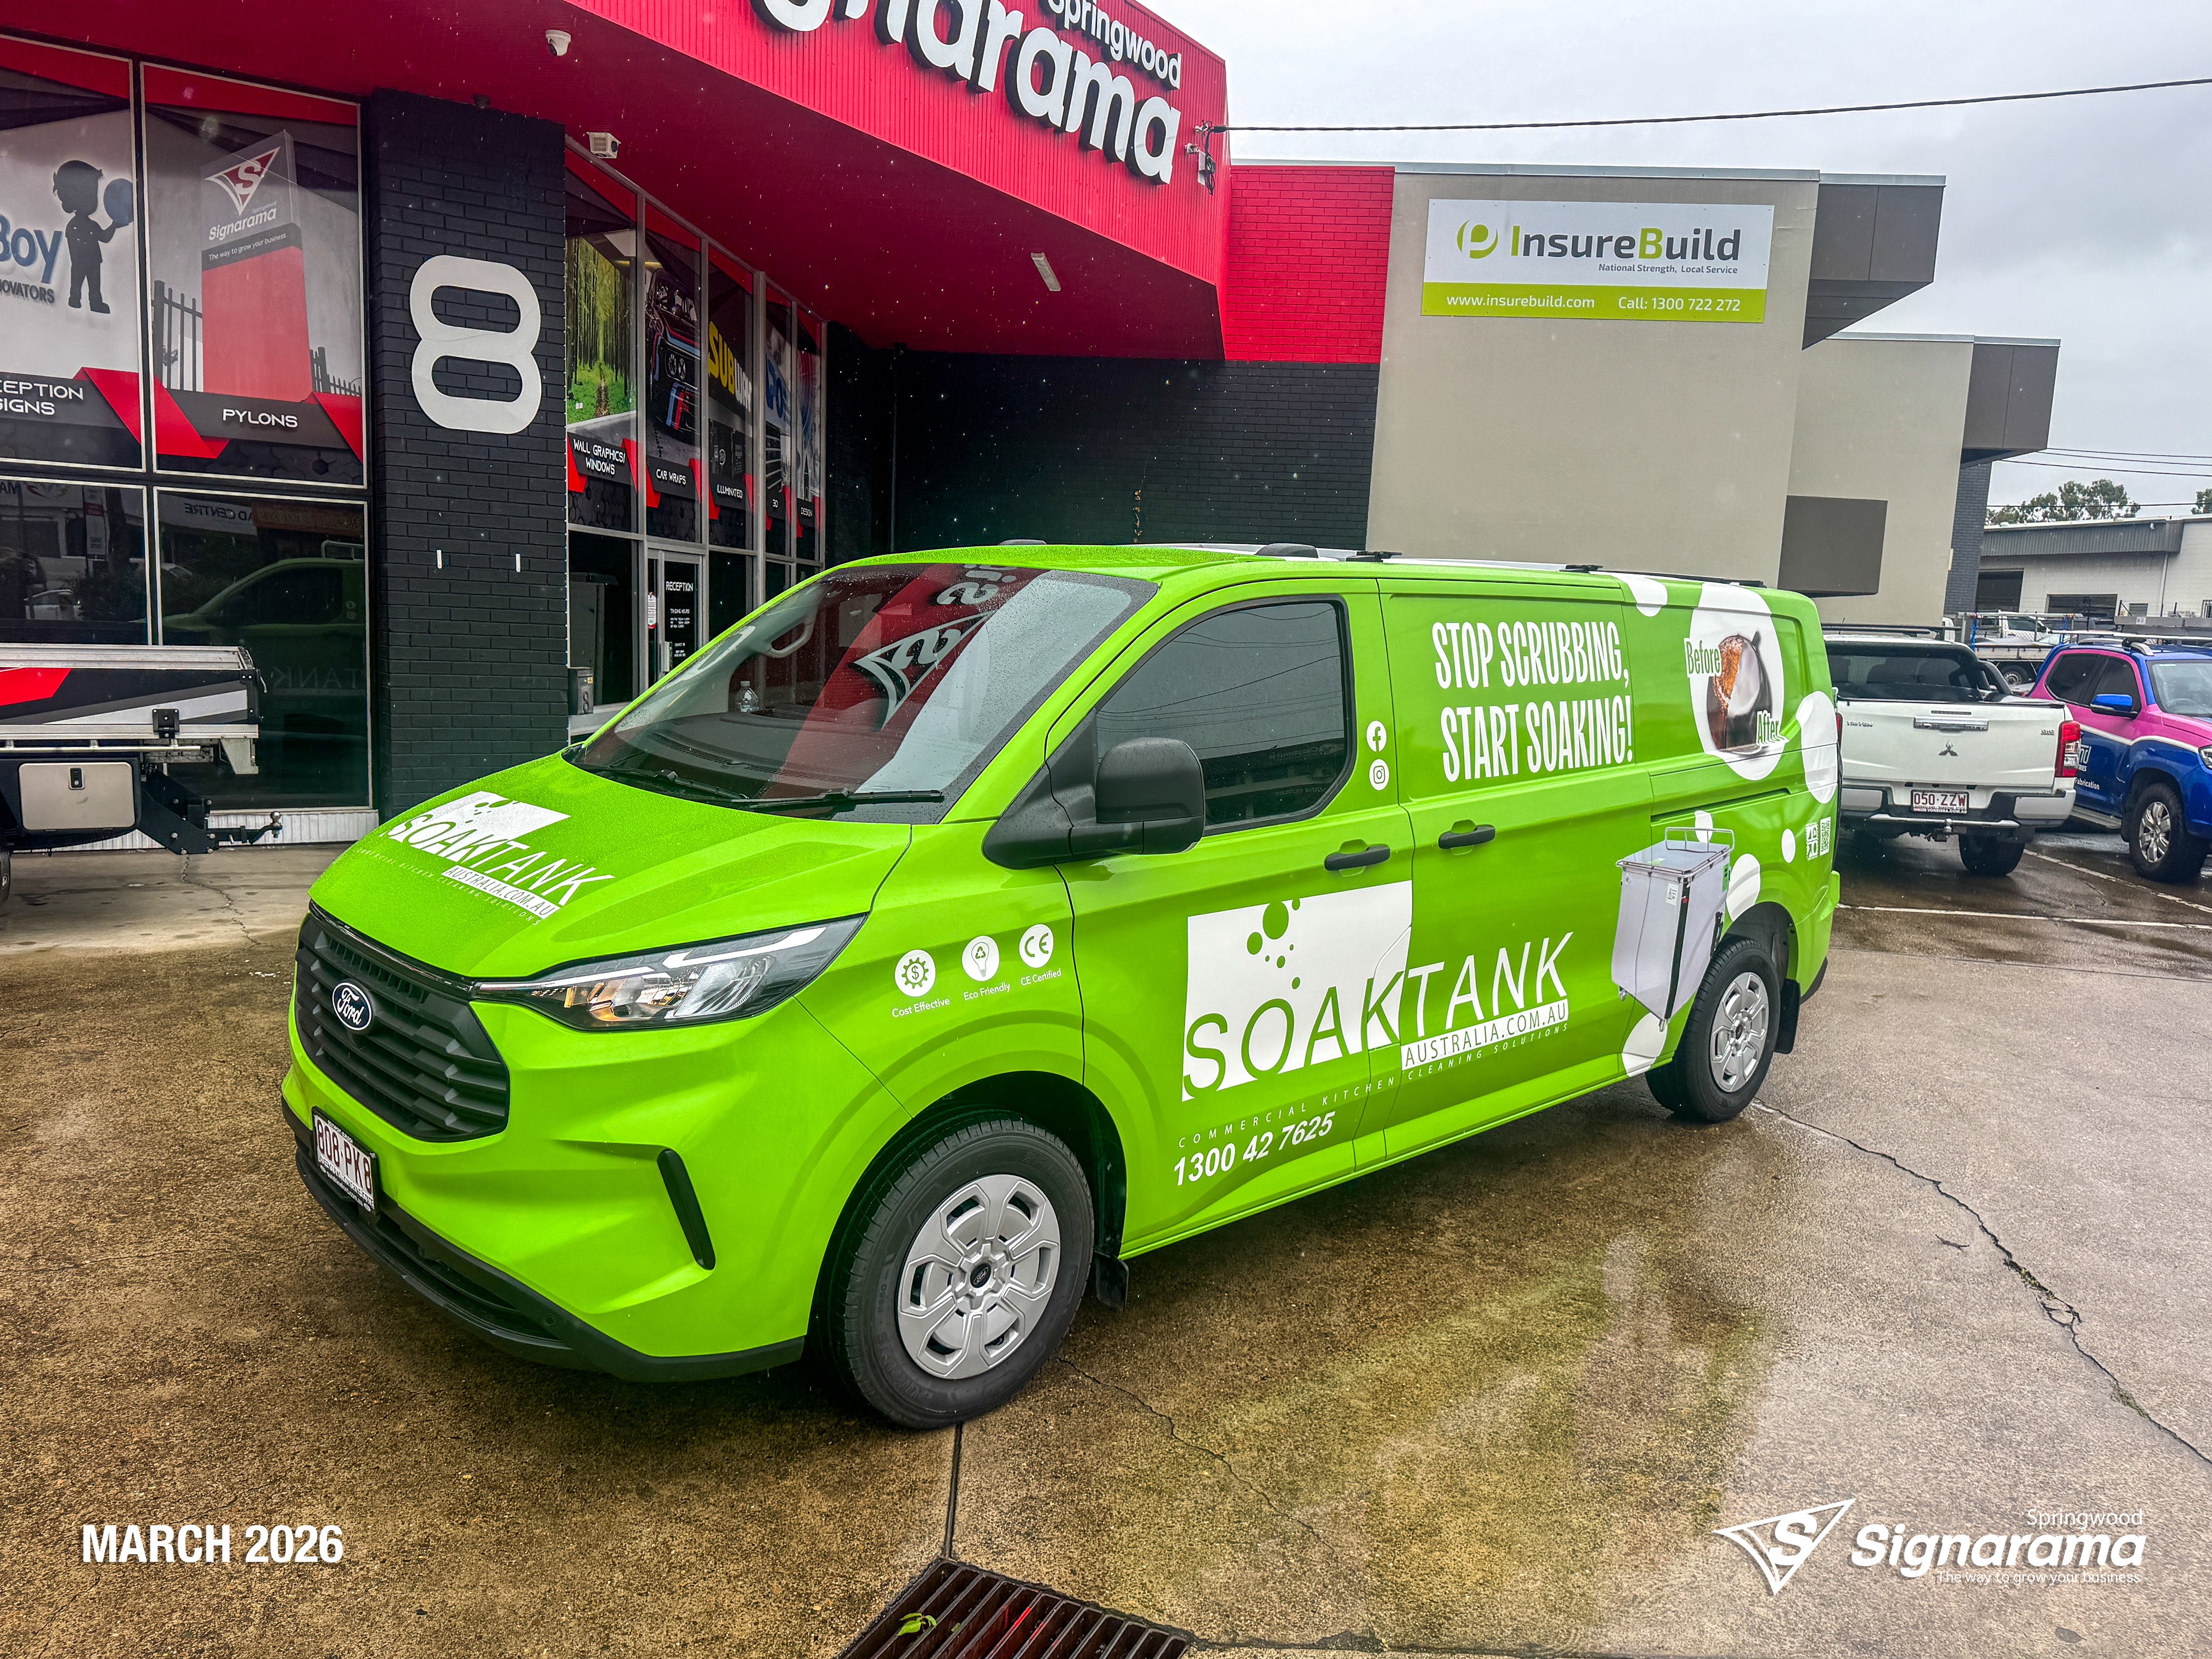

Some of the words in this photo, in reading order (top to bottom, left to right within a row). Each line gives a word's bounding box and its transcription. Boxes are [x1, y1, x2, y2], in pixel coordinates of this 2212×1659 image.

[762, 0, 1180, 184] arama
[209, 207, 277, 240] Signarama
[219, 250, 230, 258] way
[238, 243, 251, 253] grow
[252, 239, 263, 249] your
[264, 233, 286, 244] business
[1510, 224, 1741, 261] InsureBuild
[1599, 263, 1635, 273] National
[1637, 264, 1677, 275] Strength,
[1681, 265, 1704, 274] Local
[1706, 266, 1738, 274] Service
[0, 279, 55, 303] OVATORS
[1446, 295, 1595, 309] www.insurebuild.com
[1618, 296, 1647, 309] Call:
[1651, 298, 1684, 311] 1300
[1688, 298, 1712, 311] 722
[1716, 299, 1741, 312] 272
[409, 255, 542, 435] 8
[708, 321, 752, 413] SUBWAY
[0, 379, 83, 400] EPTION
[222, 408, 298, 428] PYLONS
[574, 438, 590, 454] WALL
[593, 444, 626, 464] GRAPHICS/
[586, 457, 615, 476] WINDOWS
[656, 469, 667, 481] CAR
[668, 471, 686, 486] WRAPS
[717, 484, 743, 499] ILLUMINATED
[773, 499, 779, 507] 3D
[801, 507, 813, 517] DESIGN
[666, 581, 694, 592] RECEPTION
[1432, 622, 1493, 689] STOP
[1497, 621, 1629, 688] SCRUBBING,
[1686, 640, 1720, 674] Before
[1440, 704, 1519, 782] START
[1525, 695, 1633, 774] SOAKING!
[1758, 713, 1779, 743] After
[444, 867, 558, 917] AUSTRALIA.COM.AU
[485, 896, 541, 926] SOLUTIONS
[1020, 976, 1031, 986] CE
[1032, 968, 1062, 983] Certified
[964, 990, 978, 1001] Eco
[980, 981, 1011, 998] Friendly
[337, 987, 364, 1025] Ford
[892, 1006, 912, 1018] Cost
[914, 997, 950, 1013] Effective
[1405, 1002, 1566, 1068] AUSTRALIA.COM.AU
[1179, 1103, 1306, 1148] COMMERCIAL
[1322, 1077, 1394, 1106] KITCHEN
[1408, 1050, 1483, 1080] CLEANING
[1494, 1023, 1568, 1054] SOLUTIONS
[1173, 1143, 1235, 1186] 1300
[1242, 1131, 1273, 1163] 42
[1278, 1111, 1336, 1151] 7625
